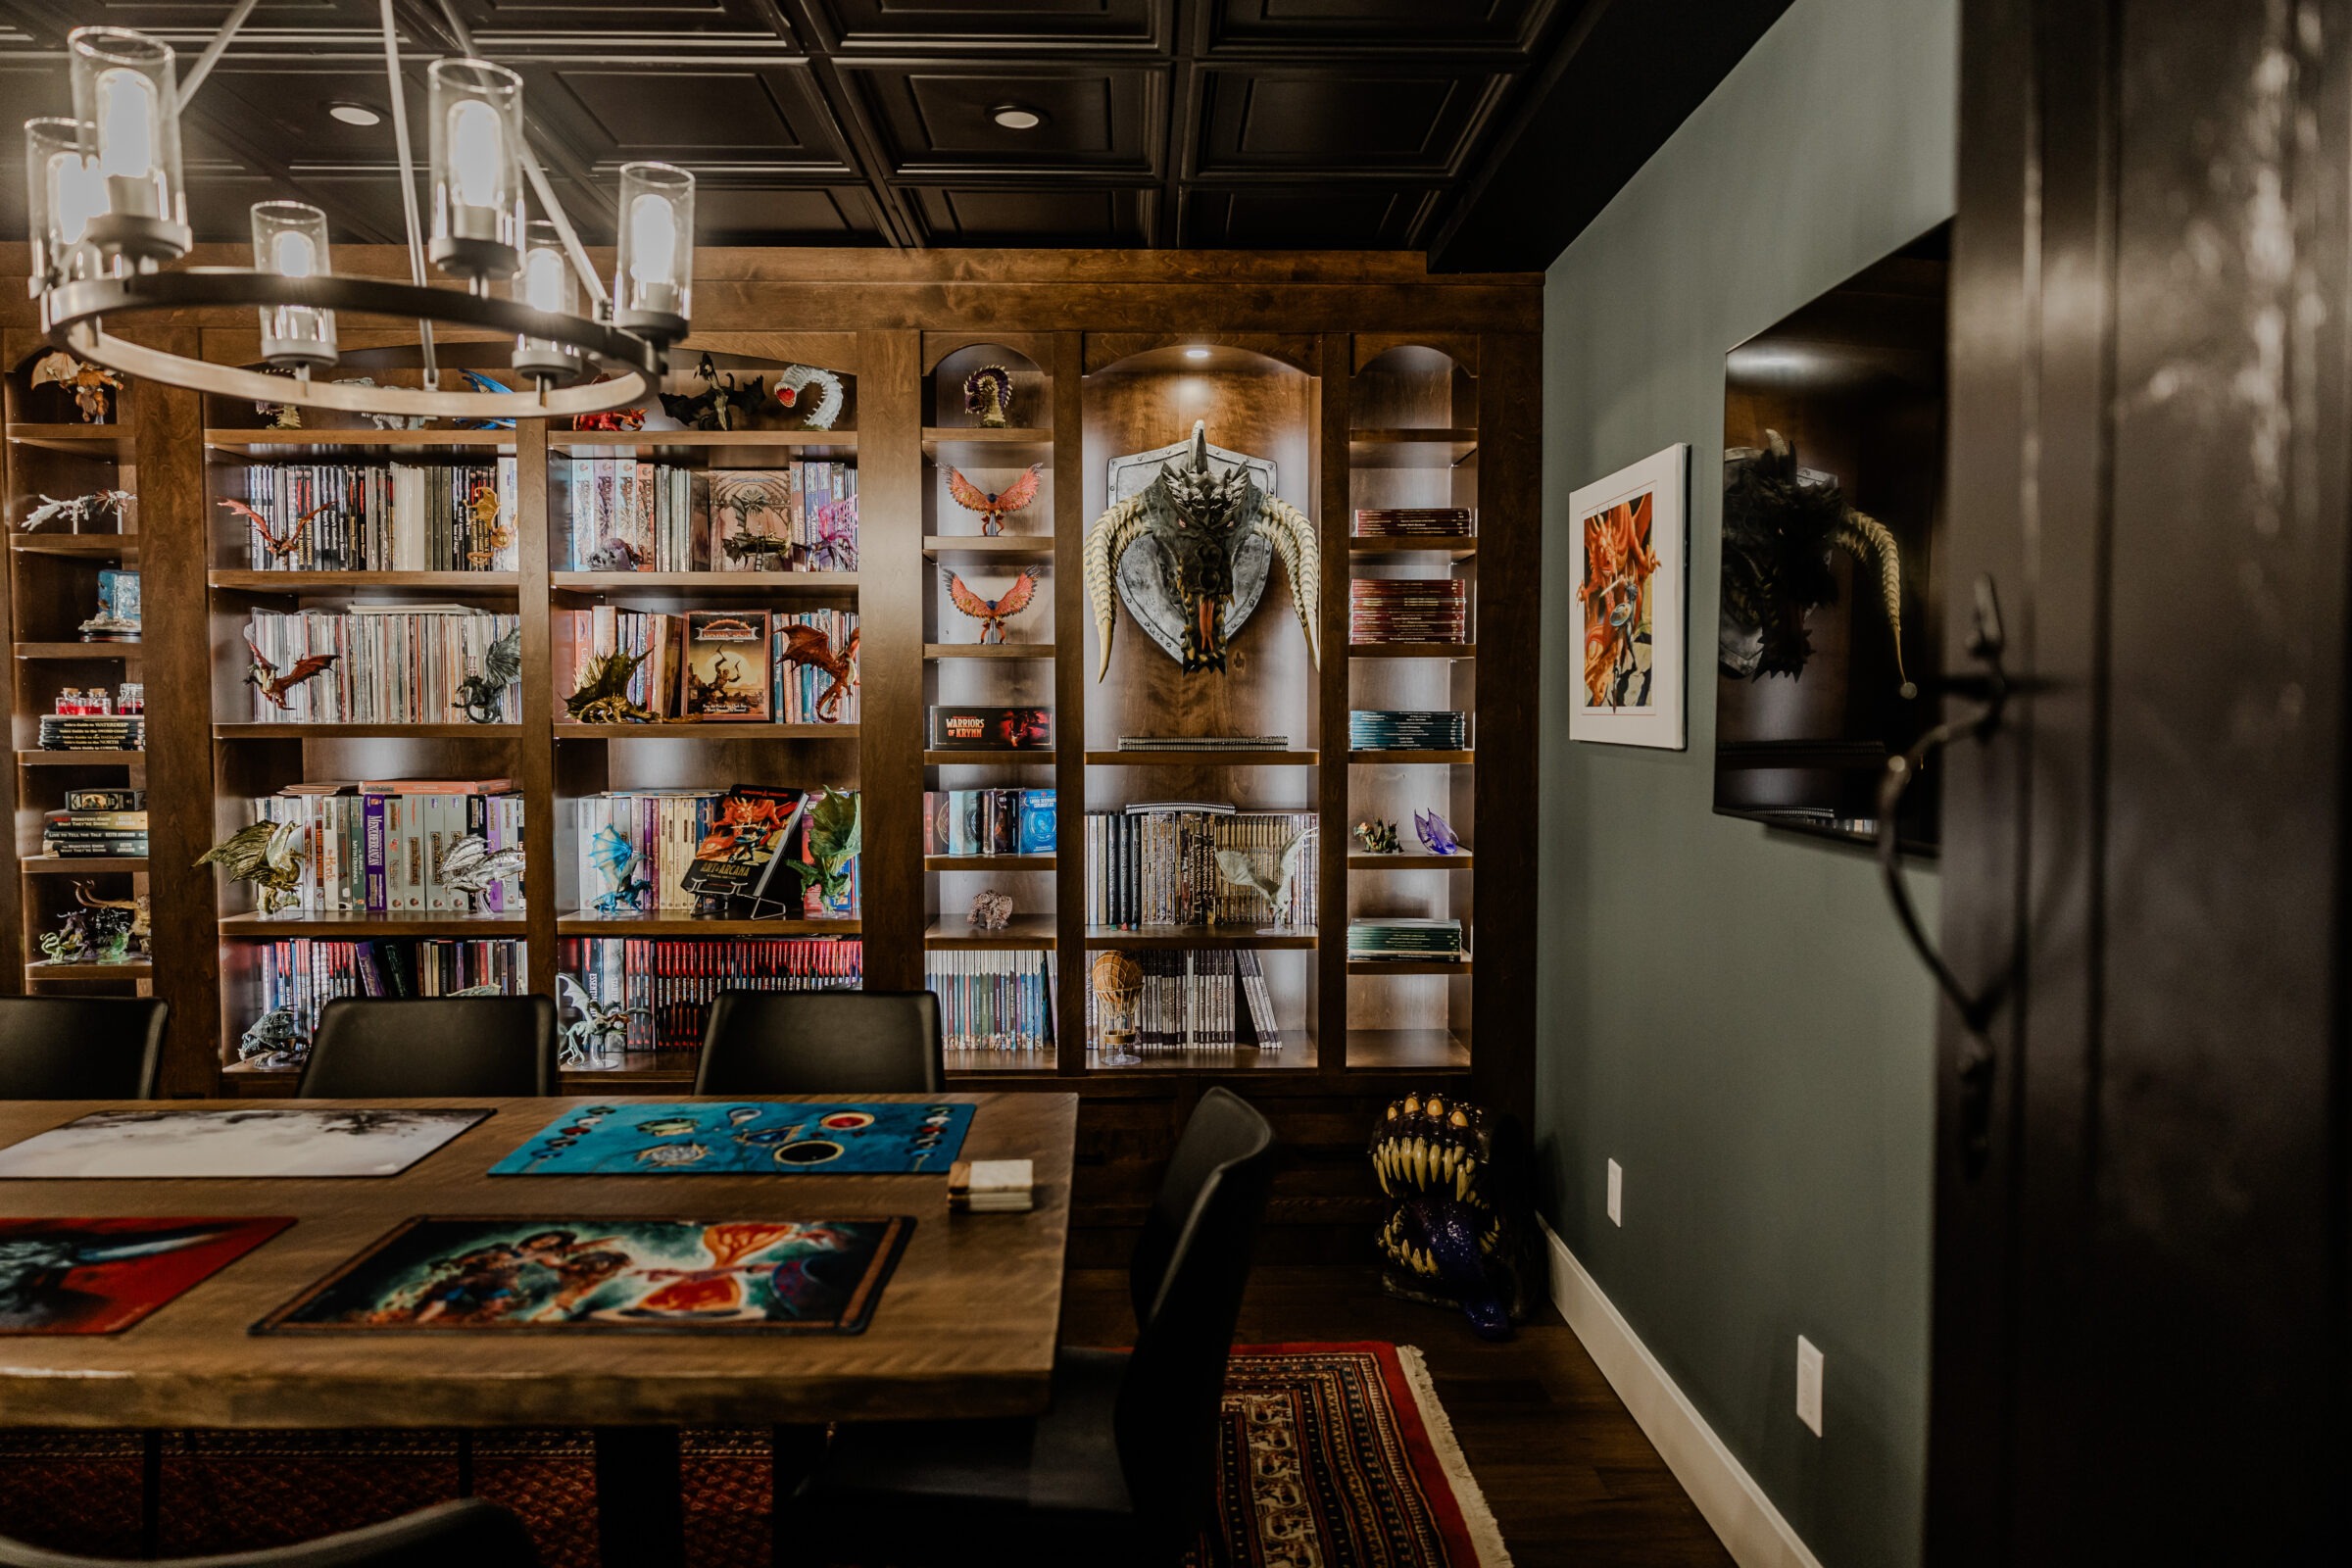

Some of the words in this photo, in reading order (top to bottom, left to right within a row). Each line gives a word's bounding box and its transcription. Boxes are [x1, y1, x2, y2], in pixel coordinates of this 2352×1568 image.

[946, 718, 985, 729] WARRIORS
[956, 728, 983, 738] KRYNN
[368, 815, 383, 866] MENZOBERRANZAN
[700, 862, 716, 872] ART
[718, 863, 751, 877] ARCANA
